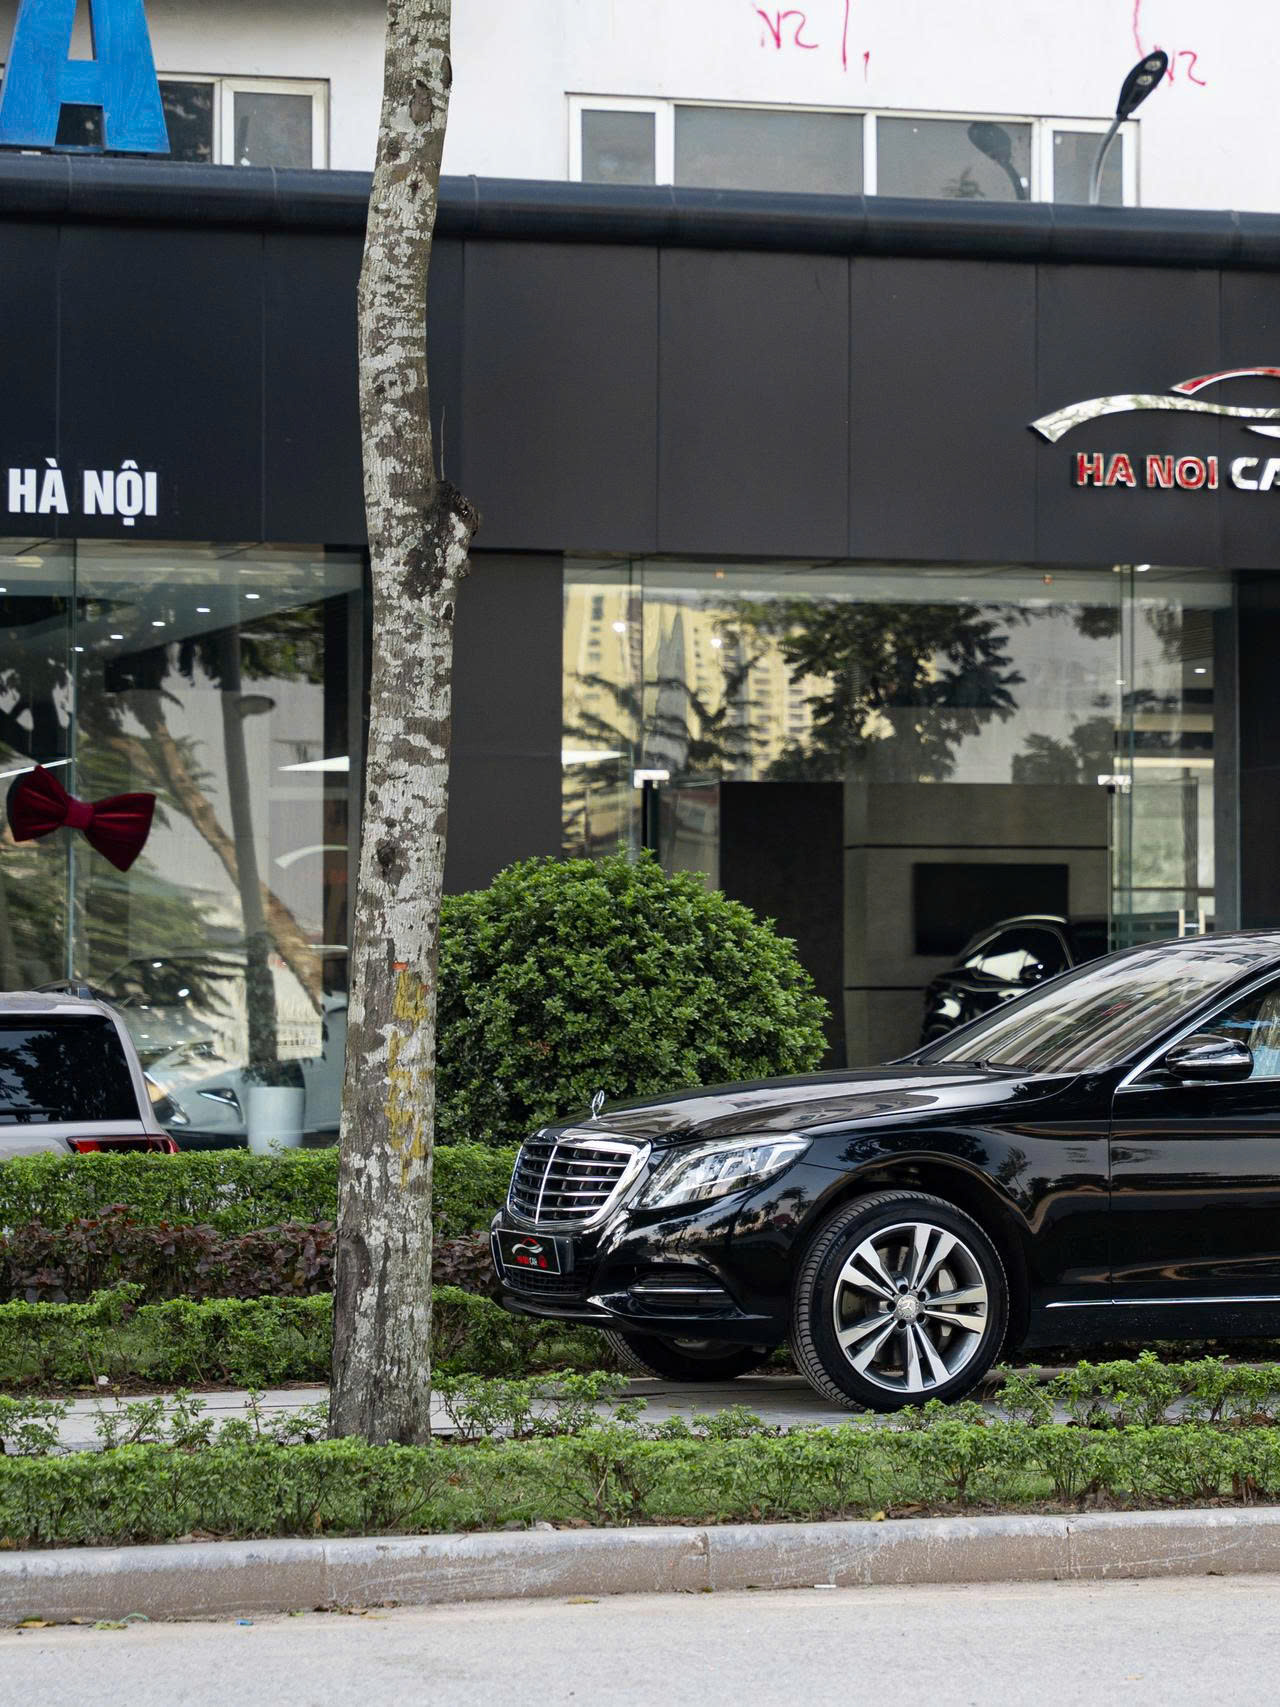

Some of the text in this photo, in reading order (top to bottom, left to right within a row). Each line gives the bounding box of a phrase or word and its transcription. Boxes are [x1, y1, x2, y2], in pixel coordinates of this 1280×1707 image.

[0, 0, 171, 153] A
[8, 457, 158, 526] HÀ NỘI
[1075, 451, 1137, 488] HA
[1145, 454, 1219, 490] NOI
